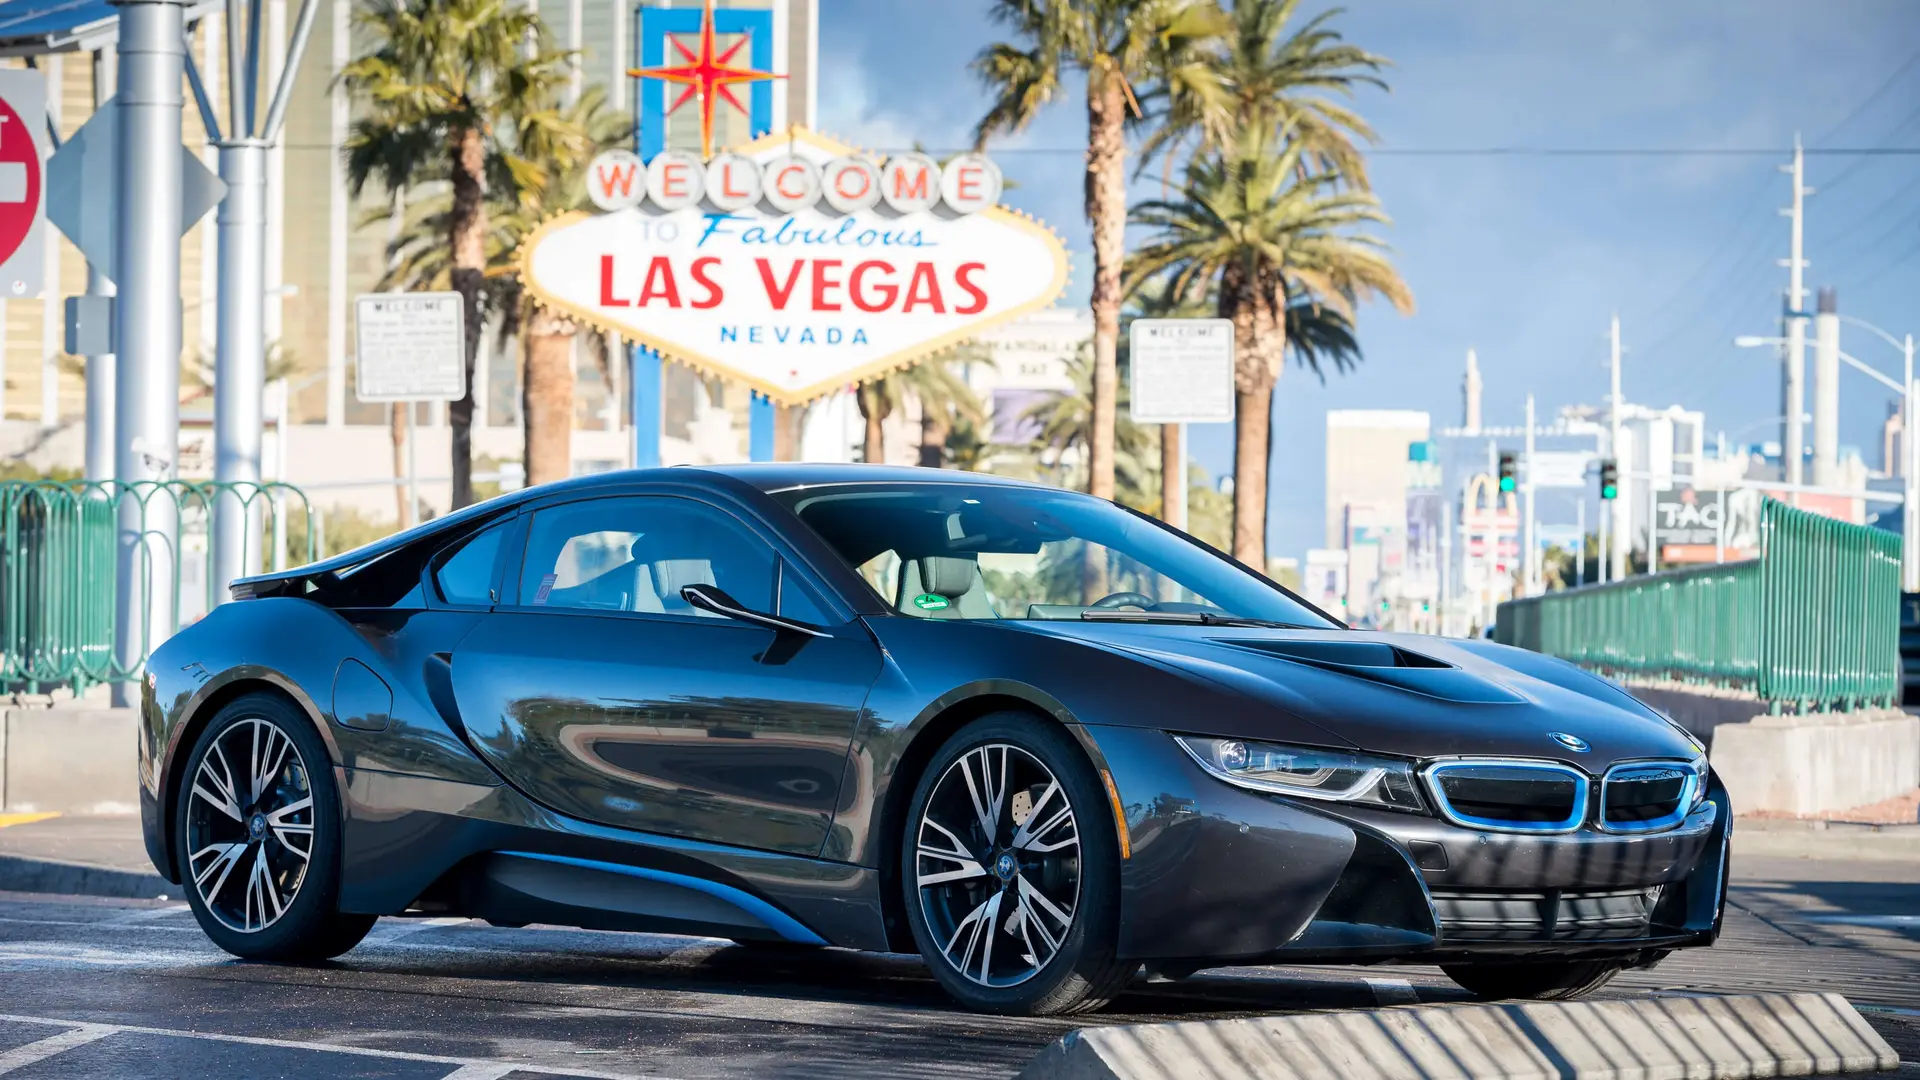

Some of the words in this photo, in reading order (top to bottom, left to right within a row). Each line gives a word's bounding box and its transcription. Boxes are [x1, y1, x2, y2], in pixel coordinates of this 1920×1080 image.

[598, 163, 983, 199] WELCOME
[641, 221, 679, 244] TO
[697, 213, 938, 248] Fabulous
[600, 254, 725, 310] LAS
[754, 258, 989, 315] VEGAS
[720, 326, 869, 346] NEVADA
